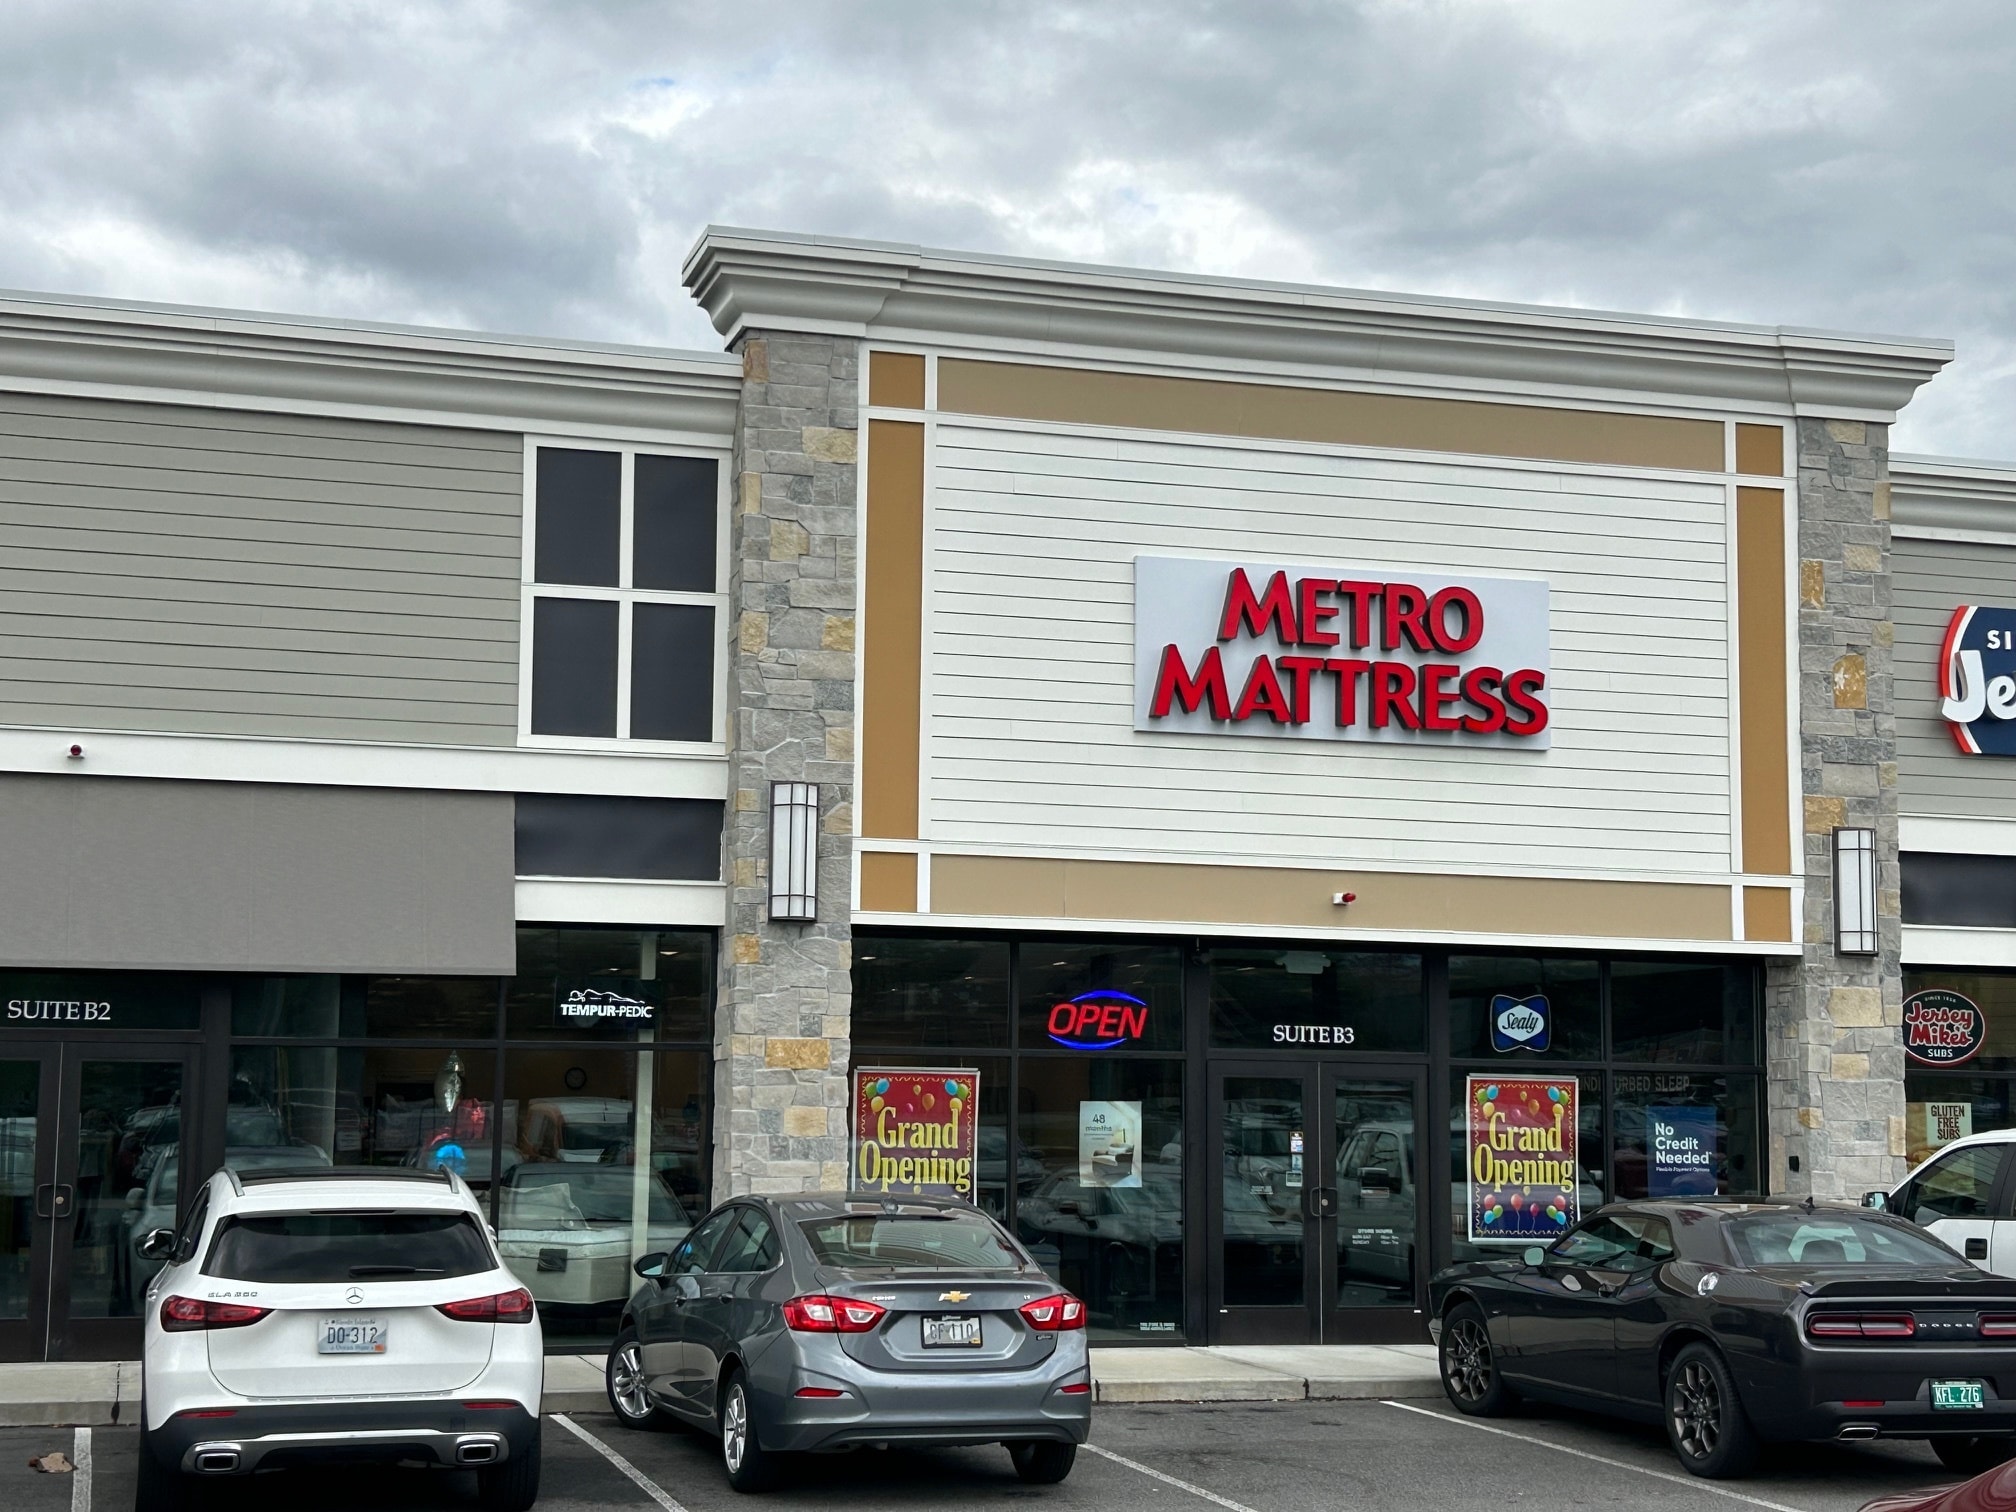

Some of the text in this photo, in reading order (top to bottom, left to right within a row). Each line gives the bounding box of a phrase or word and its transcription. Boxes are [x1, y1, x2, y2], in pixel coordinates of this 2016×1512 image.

[1216, 567, 1484, 655] METRO
[1149, 643, 1549, 735] MATTRESS
[7, 999, 111, 1021] SUITE B2
[560, 1003, 655, 1019] TEMPUR-PEDIC
[1905, 1001, 1974, 1029] Jersey
[1047, 1003, 1148, 1039] OPEN
[1501, 1012, 1539, 1034] Sealy
[1273, 1024, 1355, 1044] SUITE B3
[1927, 1048, 1953, 1058] SUBS
[1654, 1075, 1690, 1092] SLEEP
[1092, 1113, 1106, 1124] 48
[1930, 1105, 1965, 1117] GLUTEN
[877, 1106, 960, 1149] Grand
[1489, 1112, 1563, 1152] Grand
[1654, 1122, 1675, 1136] No
[1937, 1117, 1960, 1129] FREE
[1655, 1136, 1699, 1150] Credit
[1937, 1128, 1961, 1140] SUBS
[859, 1140, 972, 1193] Opening
[1473, 1143, 1575, 1194] Opening
[1934, 1387, 1980, 1403] KFL 276
